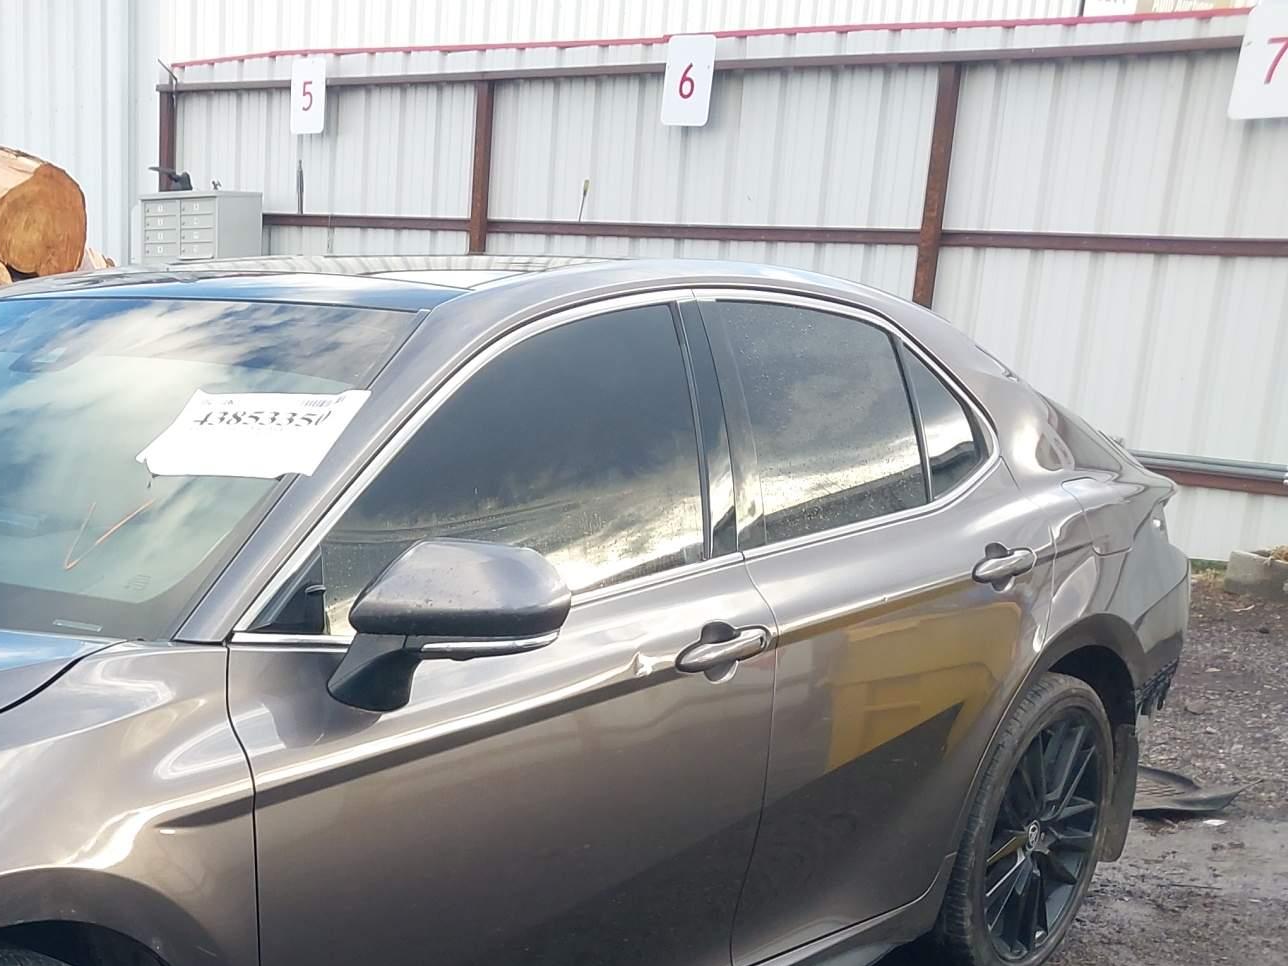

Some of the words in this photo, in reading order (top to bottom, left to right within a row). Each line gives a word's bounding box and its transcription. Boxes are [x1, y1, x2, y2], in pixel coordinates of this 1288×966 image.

[1264, 37, 1288, 84] 7
[301, 81, 313, 111] 5
[678, 62, 695, 99] 6
